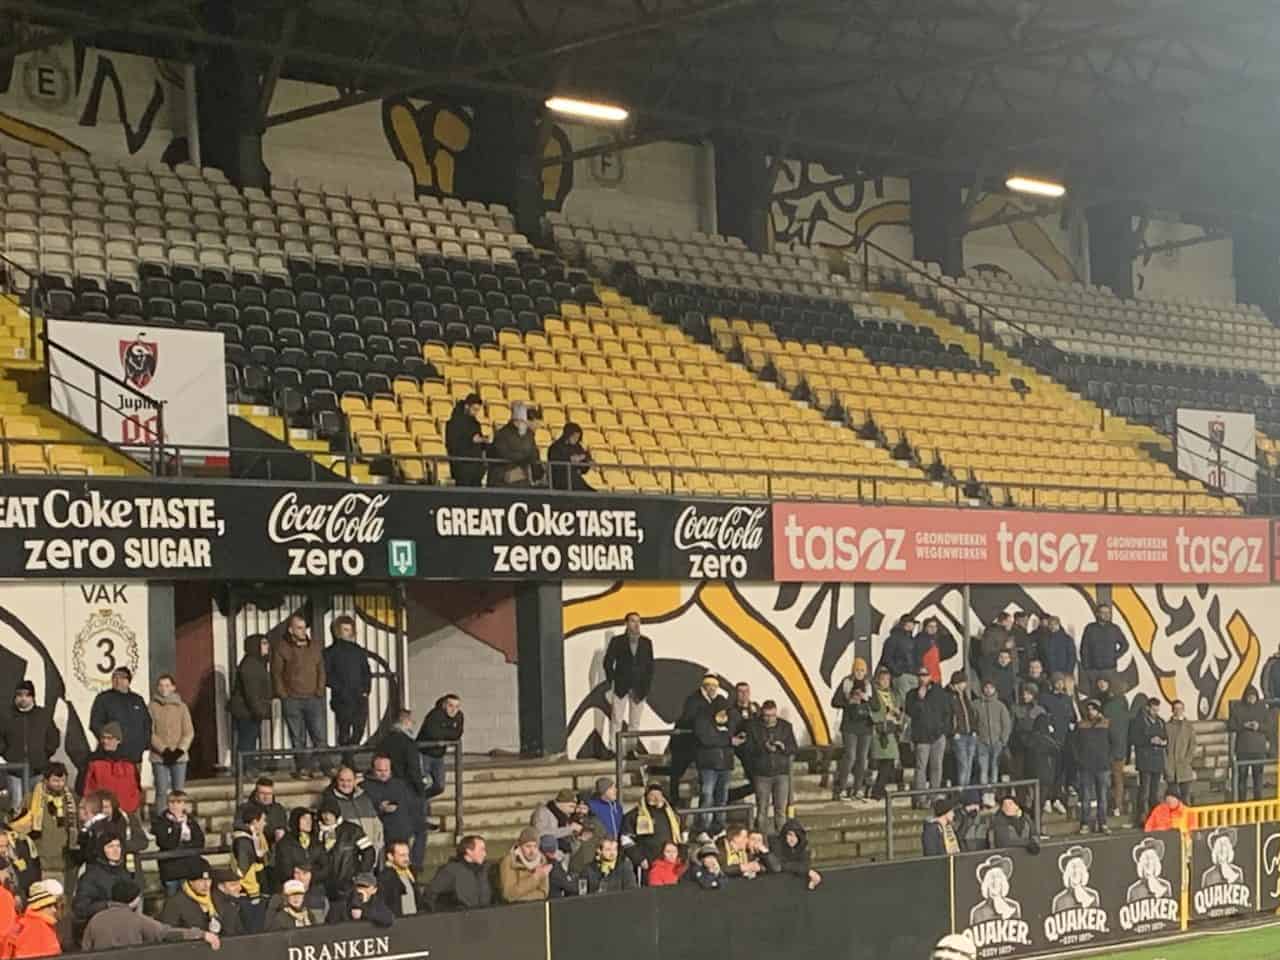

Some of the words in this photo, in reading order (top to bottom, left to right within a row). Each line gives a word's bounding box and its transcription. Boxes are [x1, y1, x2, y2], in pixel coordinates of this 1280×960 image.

[118, 394, 168, 411] Jupir
[44, 489, 133, 530] Coke
[135, 498, 225, 536] TASTE,
[268, 492, 390, 544] Coca-Cola
[436, 507, 504, 538] GREAT
[507, 503, 575, 537] Coke
[576, 510, 644, 543] TASTE,
[674, 505, 767, 551] Coca-Cola
[24, 539, 116, 571] zero
[125, 537, 212, 569] SUGAR
[288, 548, 365, 576] zero
[494, 544, 562, 572] zero
[568, 546, 634, 572] SUGAR
[689, 553, 748, 579] zero
[81, 584, 128, 604] VAK
[96, 637, 116, 674] 3
[1120, 898, 1178, 930] QUAKER
[1194, 884, 1250, 915] QUAKER
[1044, 908, 1107, 942] QUAKER
